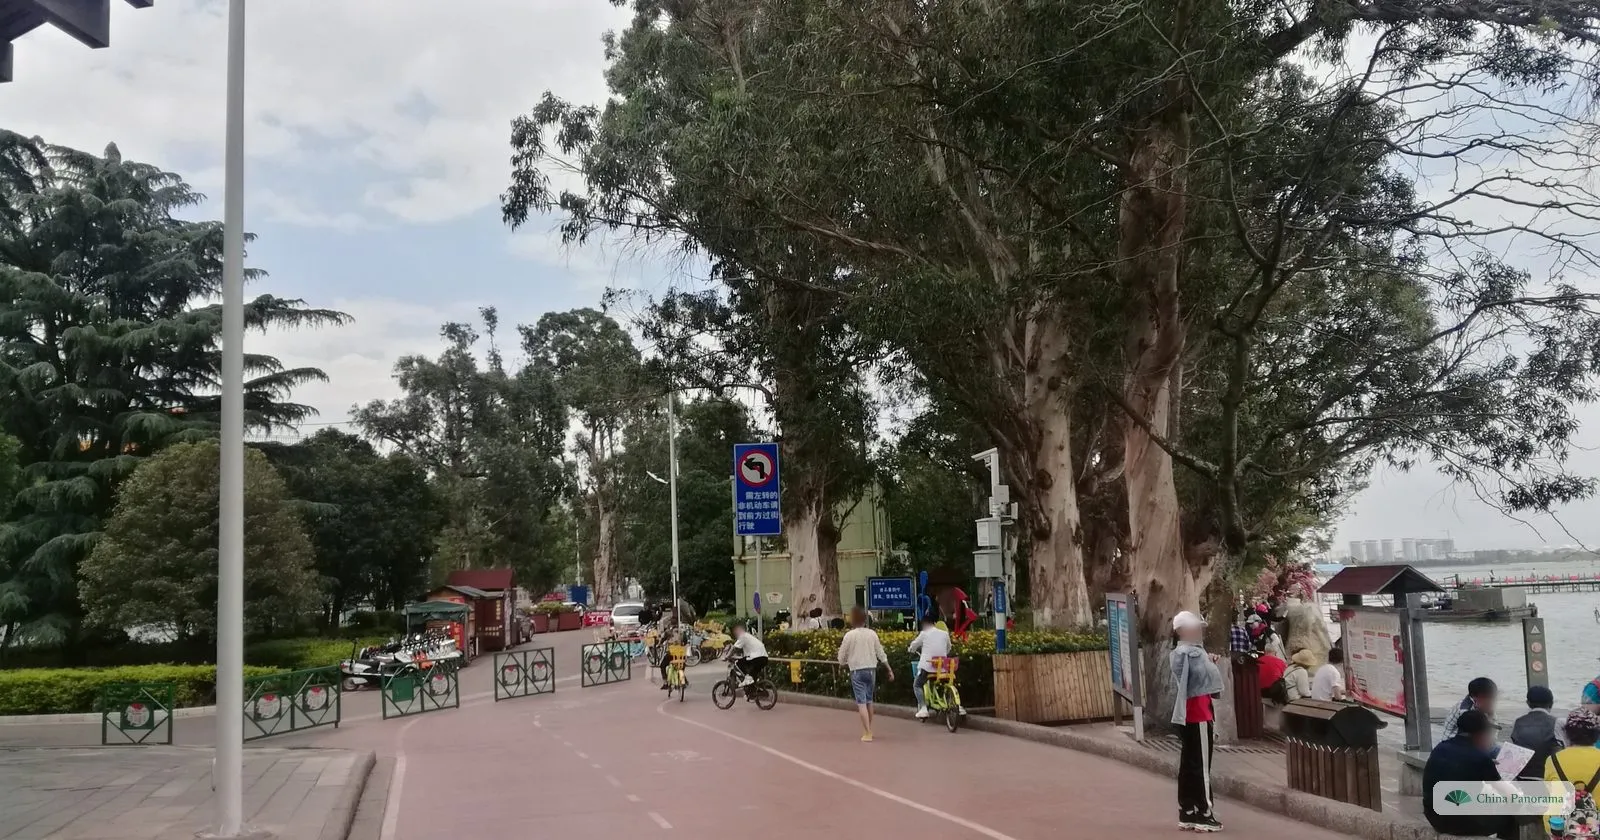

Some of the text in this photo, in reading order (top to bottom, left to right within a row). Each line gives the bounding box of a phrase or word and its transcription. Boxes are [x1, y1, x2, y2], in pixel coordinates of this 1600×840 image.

[746, 492, 777, 500] 需左转的
[738, 501, 778, 510] 非机动车请
[738, 511, 778, 520] 到前方过街
[739, 522, 755, 530] 行驶
